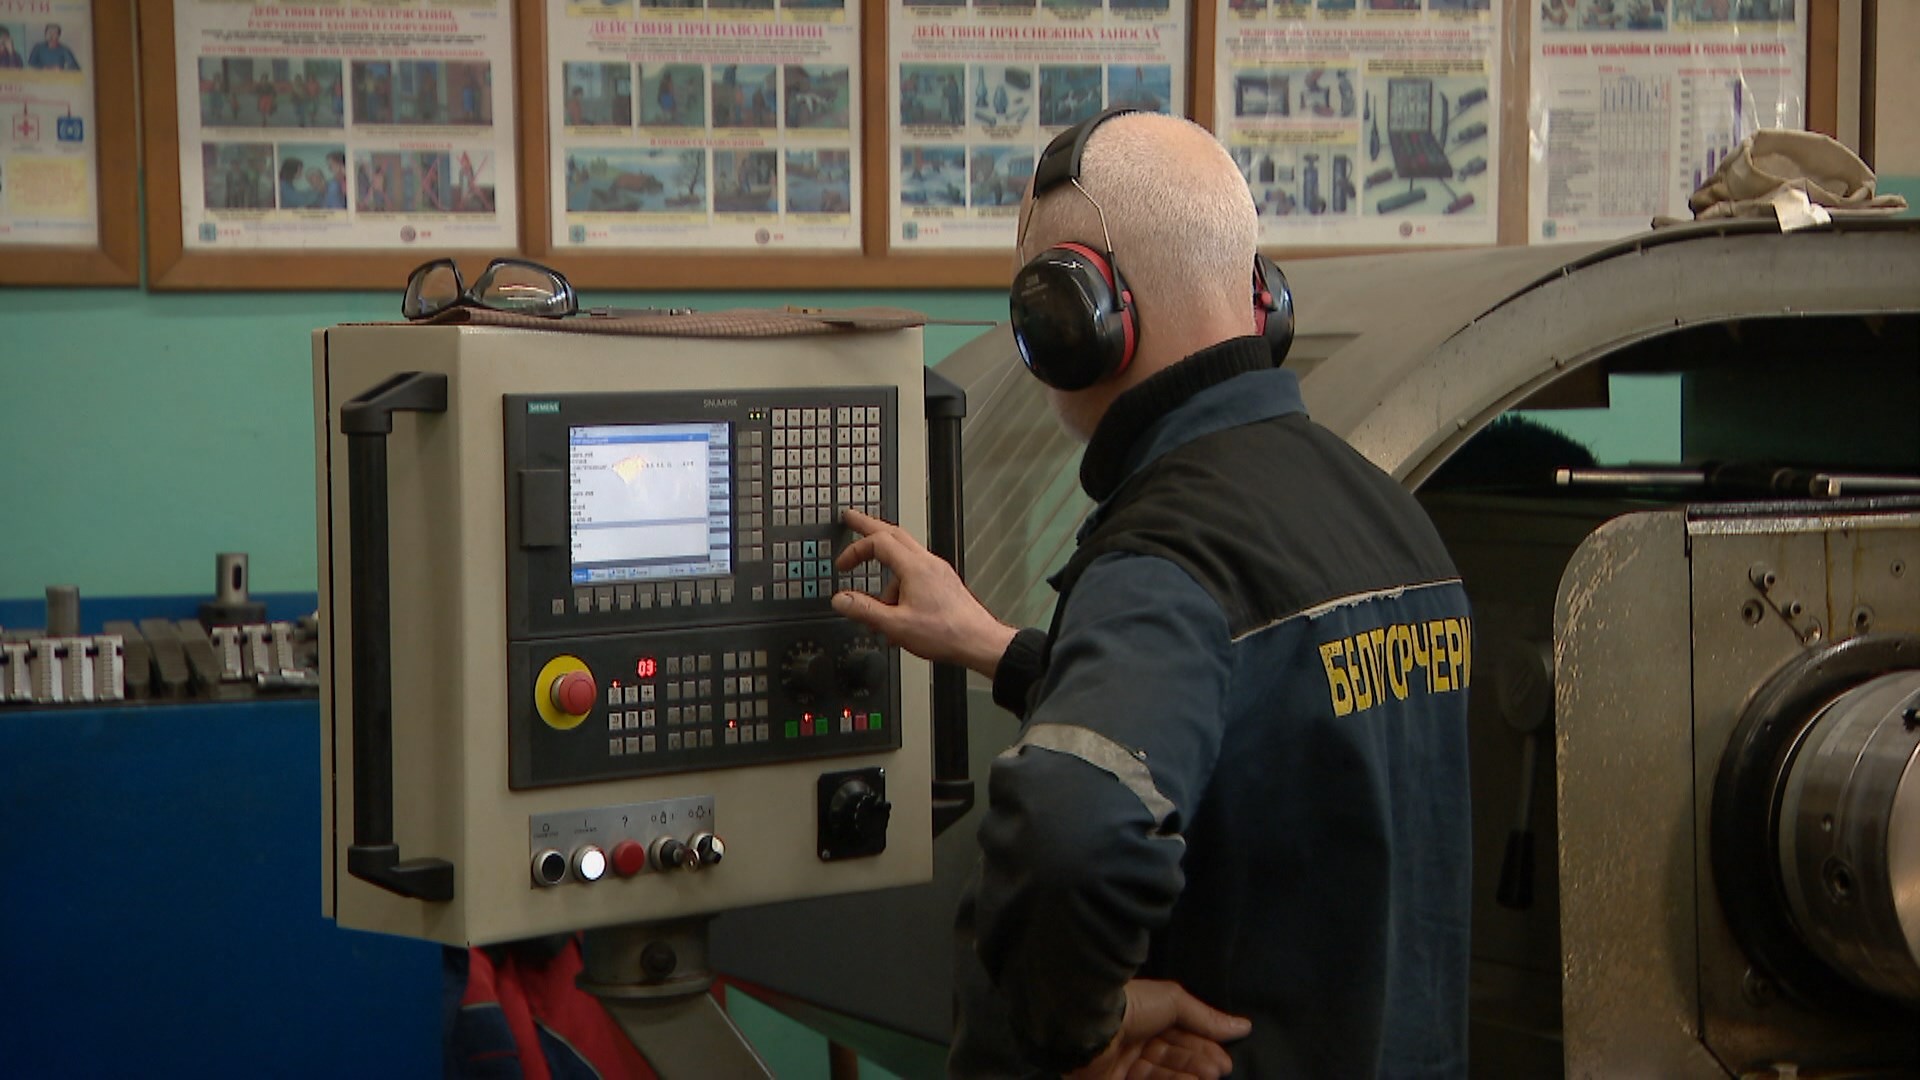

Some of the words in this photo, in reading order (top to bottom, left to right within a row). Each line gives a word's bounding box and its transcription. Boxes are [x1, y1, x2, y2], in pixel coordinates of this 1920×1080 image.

[912, 23, 985, 39] ДЕЙСТВИЯ
[990, 26, 1018, 40] ПРИ
[1022, 26, 1093, 40] СНЕЖНЫХ
[1100, 27, 1160, 41] ЗАНОСАХ
[528, 402, 560, 413] SIEMENS
